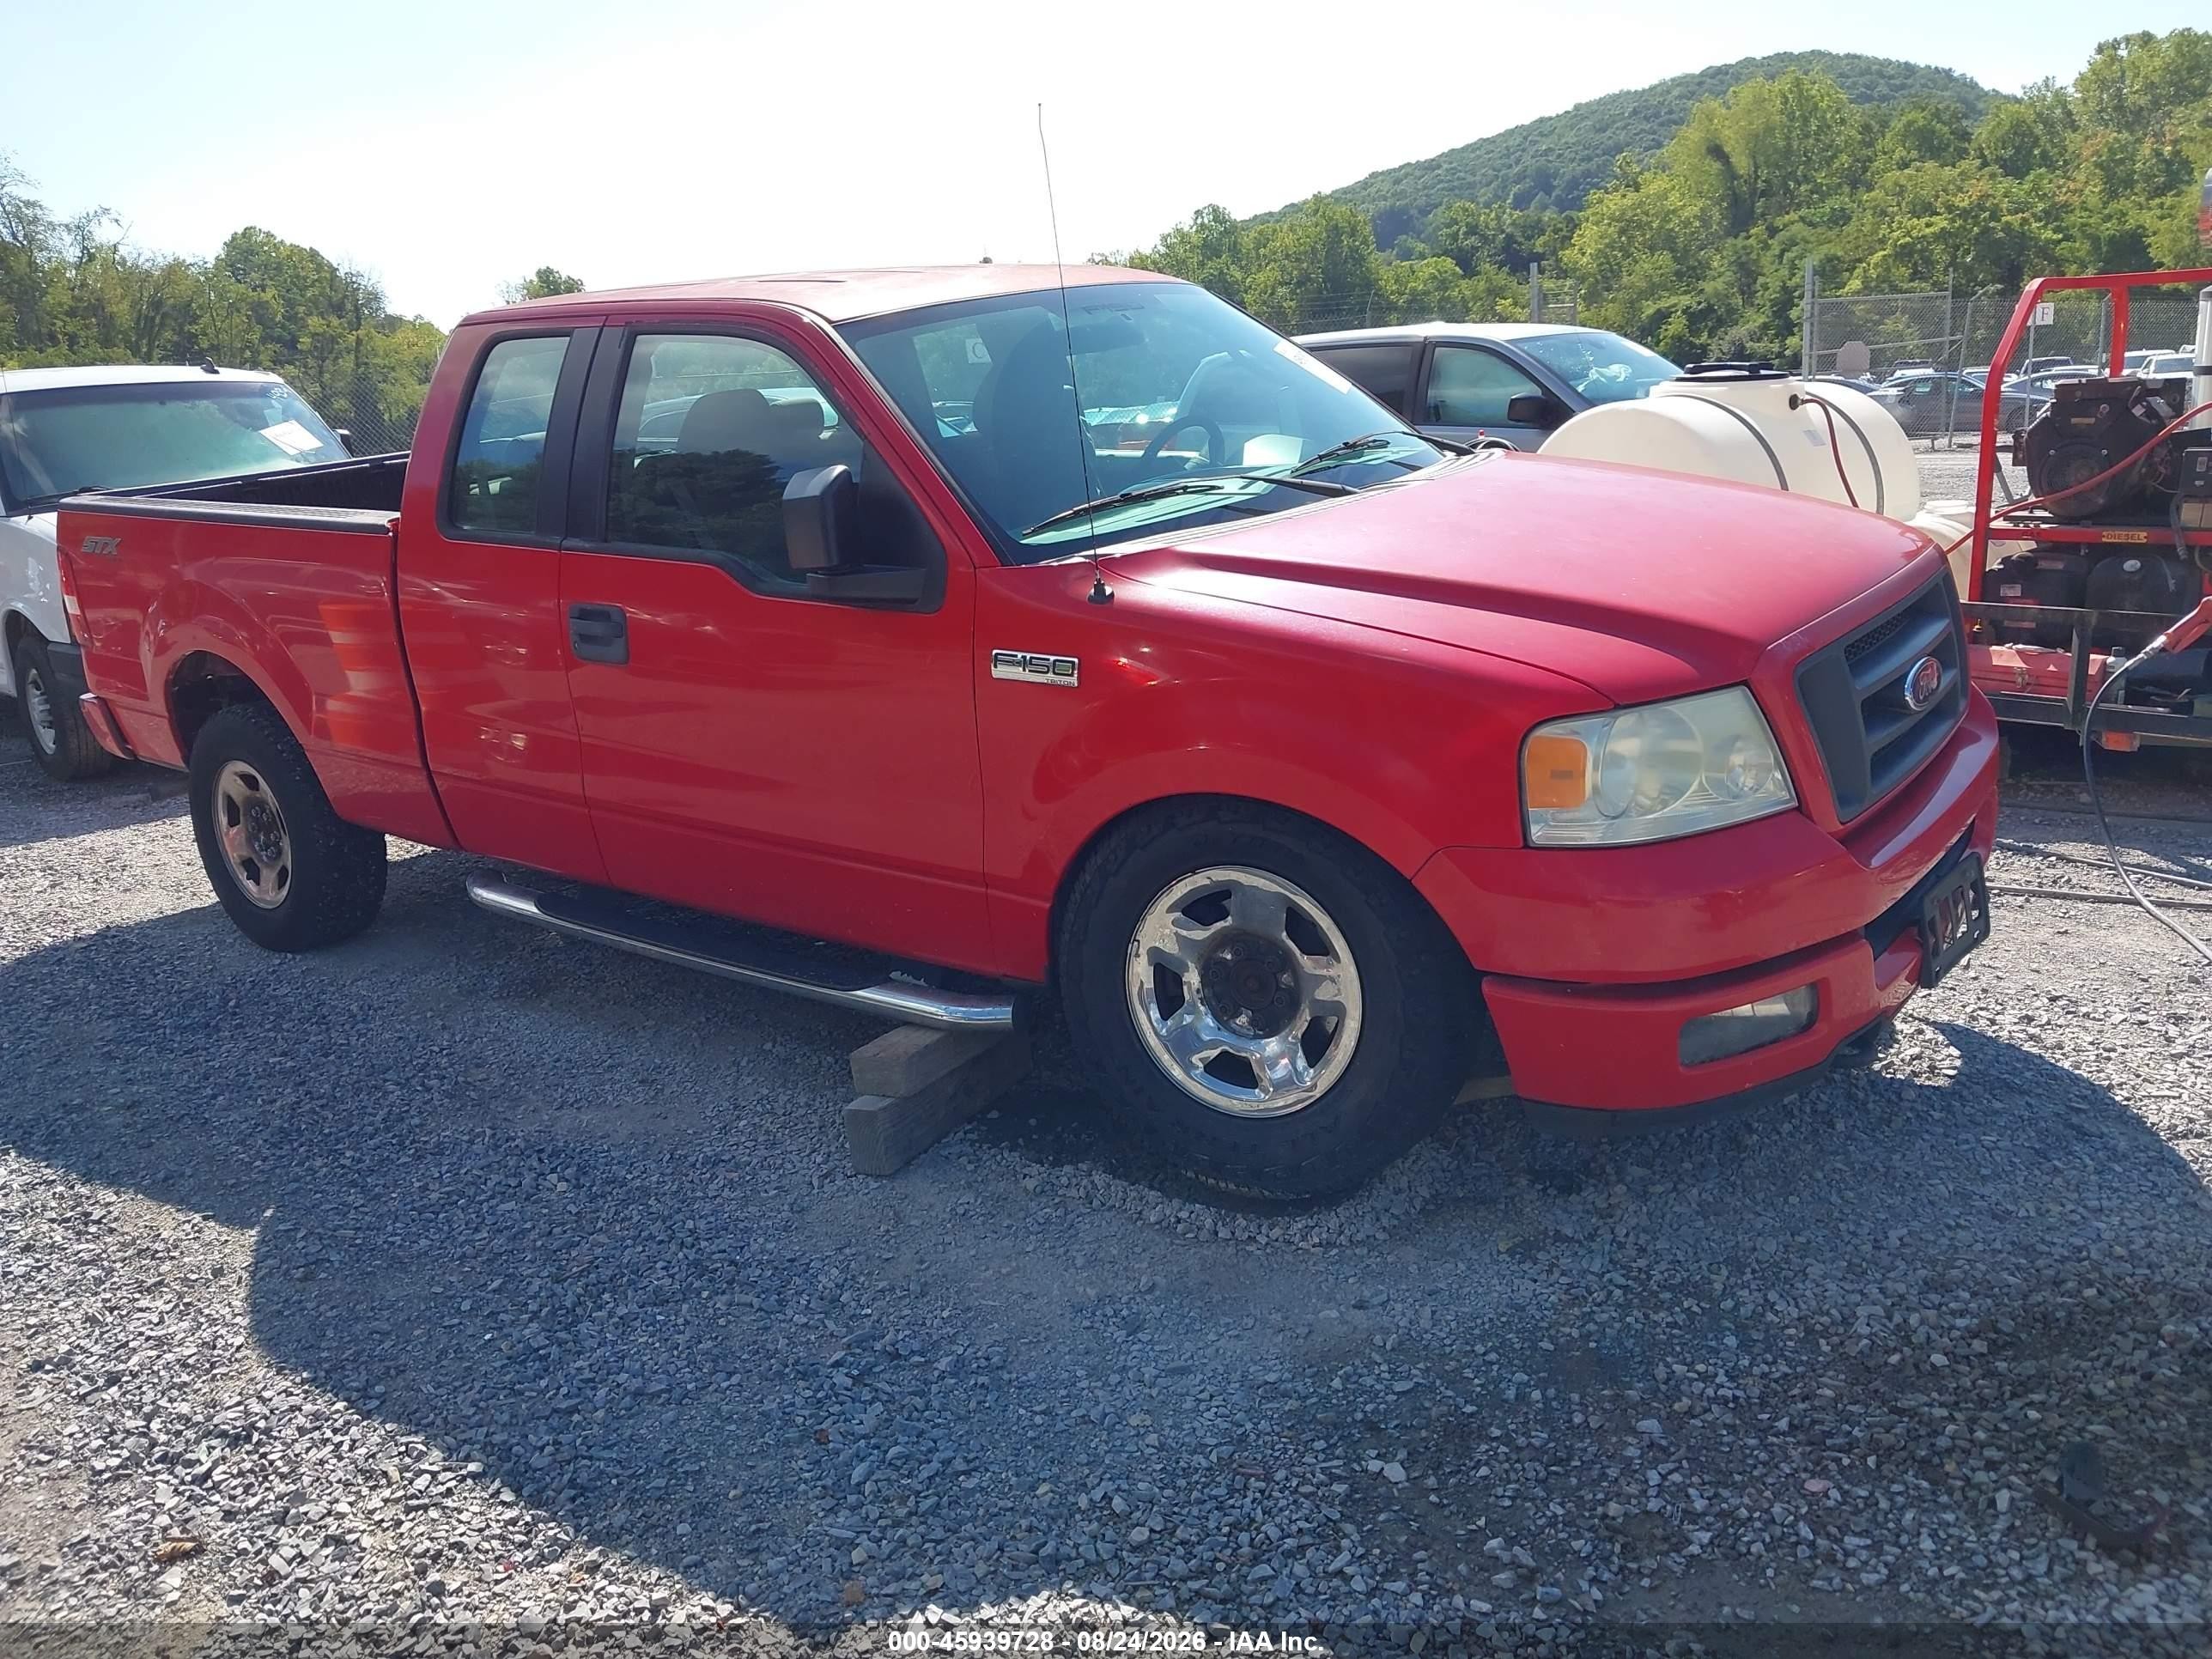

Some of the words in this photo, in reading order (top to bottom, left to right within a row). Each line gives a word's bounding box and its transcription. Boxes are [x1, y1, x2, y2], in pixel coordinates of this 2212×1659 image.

[2039, 307, 2050, 322] F
[2106, 532, 2143, 542] DIESEL
[82, 536, 122, 556] STX
[1044, 678, 1076, 687] TRITON
